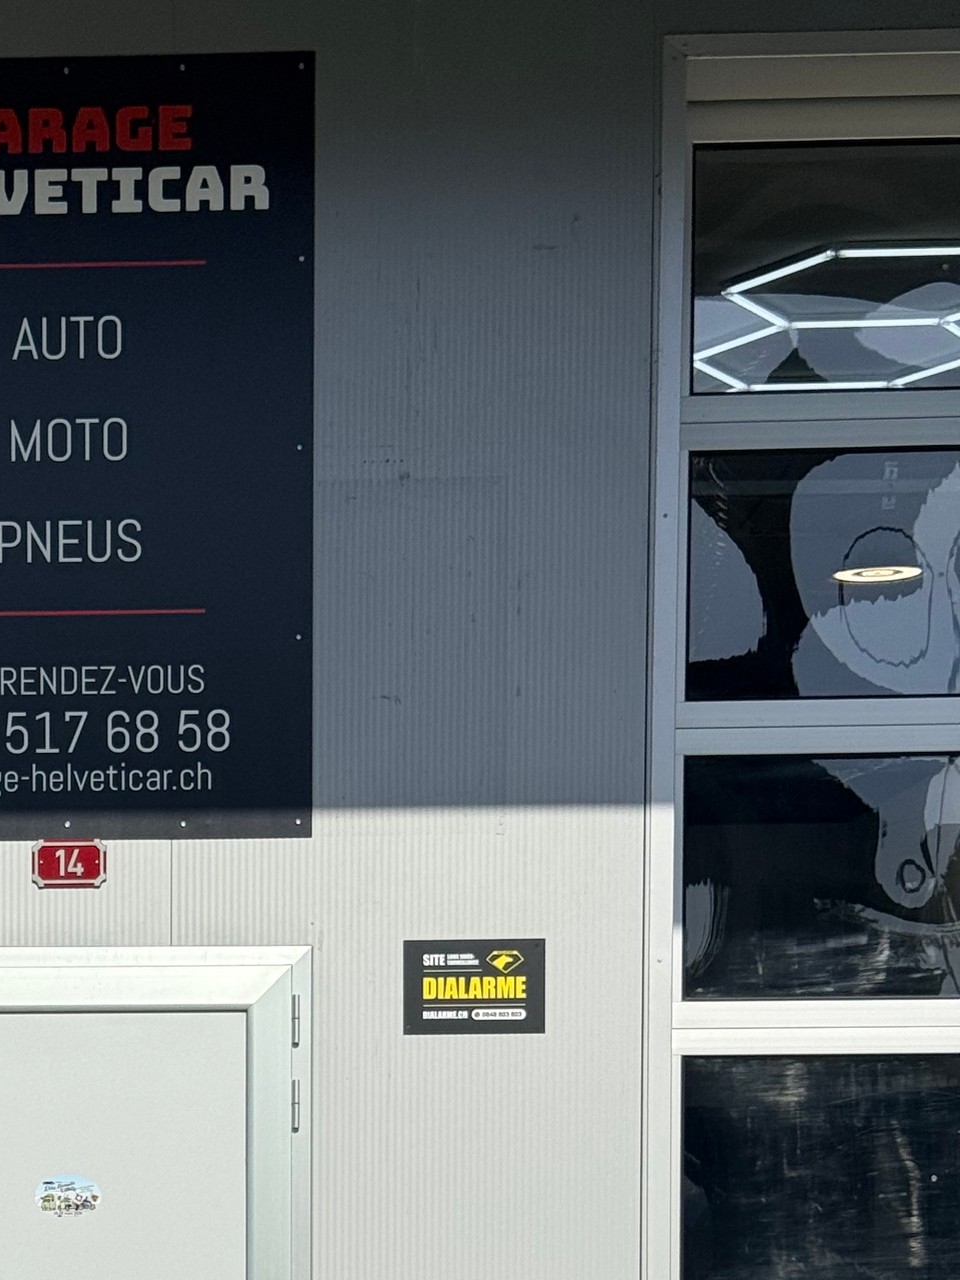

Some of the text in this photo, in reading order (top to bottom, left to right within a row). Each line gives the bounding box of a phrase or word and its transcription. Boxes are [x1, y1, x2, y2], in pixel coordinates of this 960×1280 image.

[12, 315, 122, 361] AUTO
[10, 417, 128, 462] MOTO
[0, 664, 205, 696] RENDEZ-VOUS
[5, 710, 89, 755] 517
[106, 709, 160, 753] 68
[177, 708, 231, 753] 58
[54, 848, 85, 877] 14
[422, 953, 446, 966] SITE
[422, 975, 528, 1000] DIALARME
